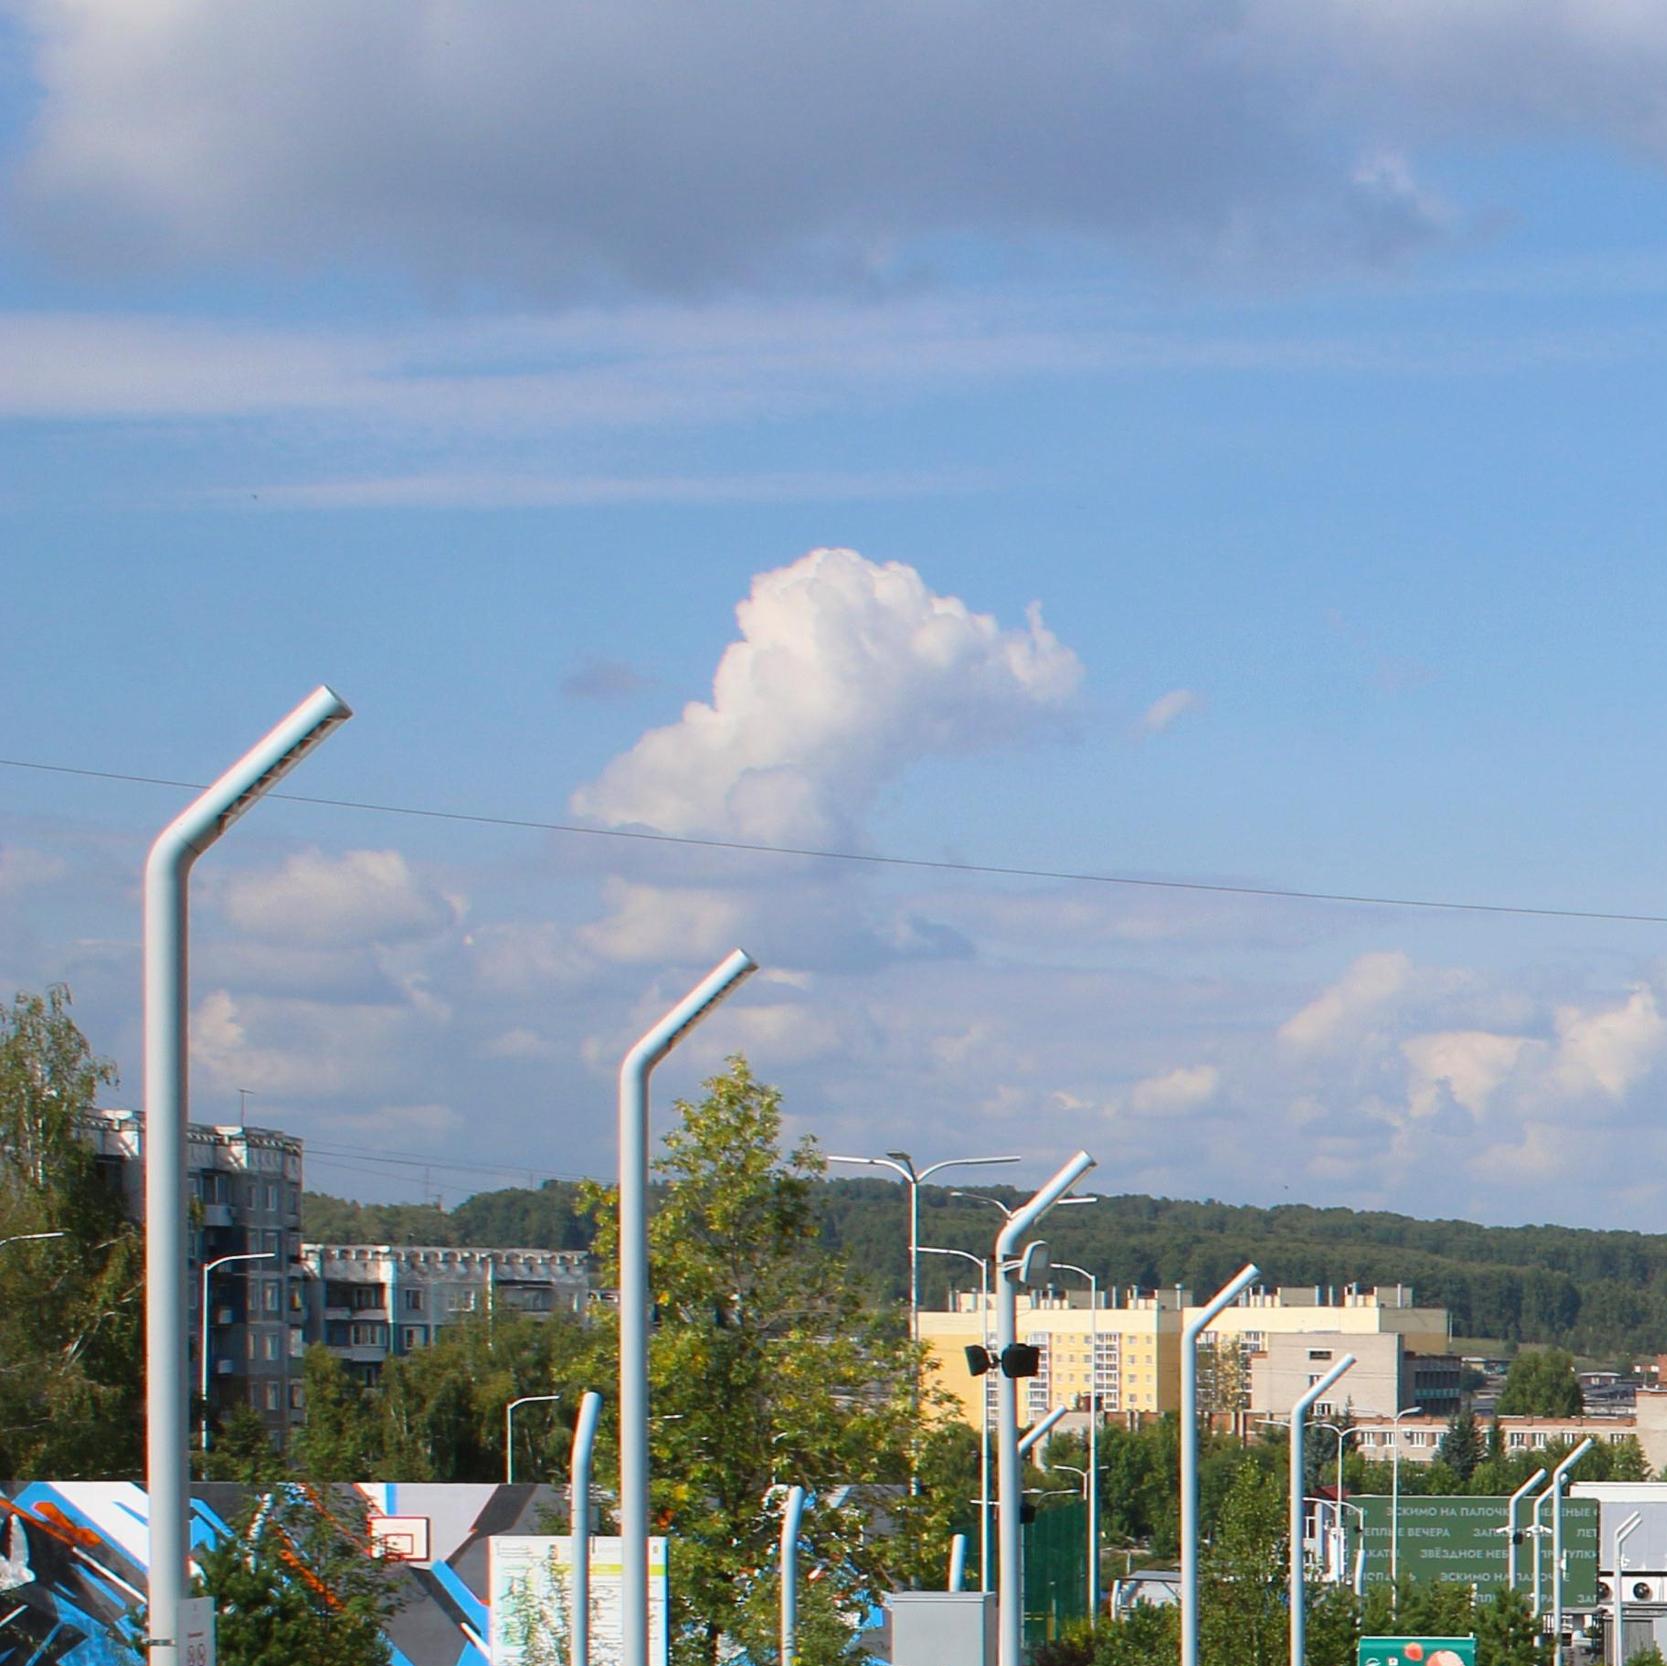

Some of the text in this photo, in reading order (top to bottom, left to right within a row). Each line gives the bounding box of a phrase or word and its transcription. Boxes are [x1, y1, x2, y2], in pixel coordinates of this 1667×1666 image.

[1440, 1507, 1458, 1517] НА
[1460, 1507, 1511, 1517] ПАЛОЧК
[1364, 1527, 1451, 1537] ЕПЛЕ ВЕЧЕРА
[1420, 1546, 1510, 1559] ЗВЁЗДНОЕ НЕБ
[1439, 1572, 1491, 1582] ЭСКИМО
